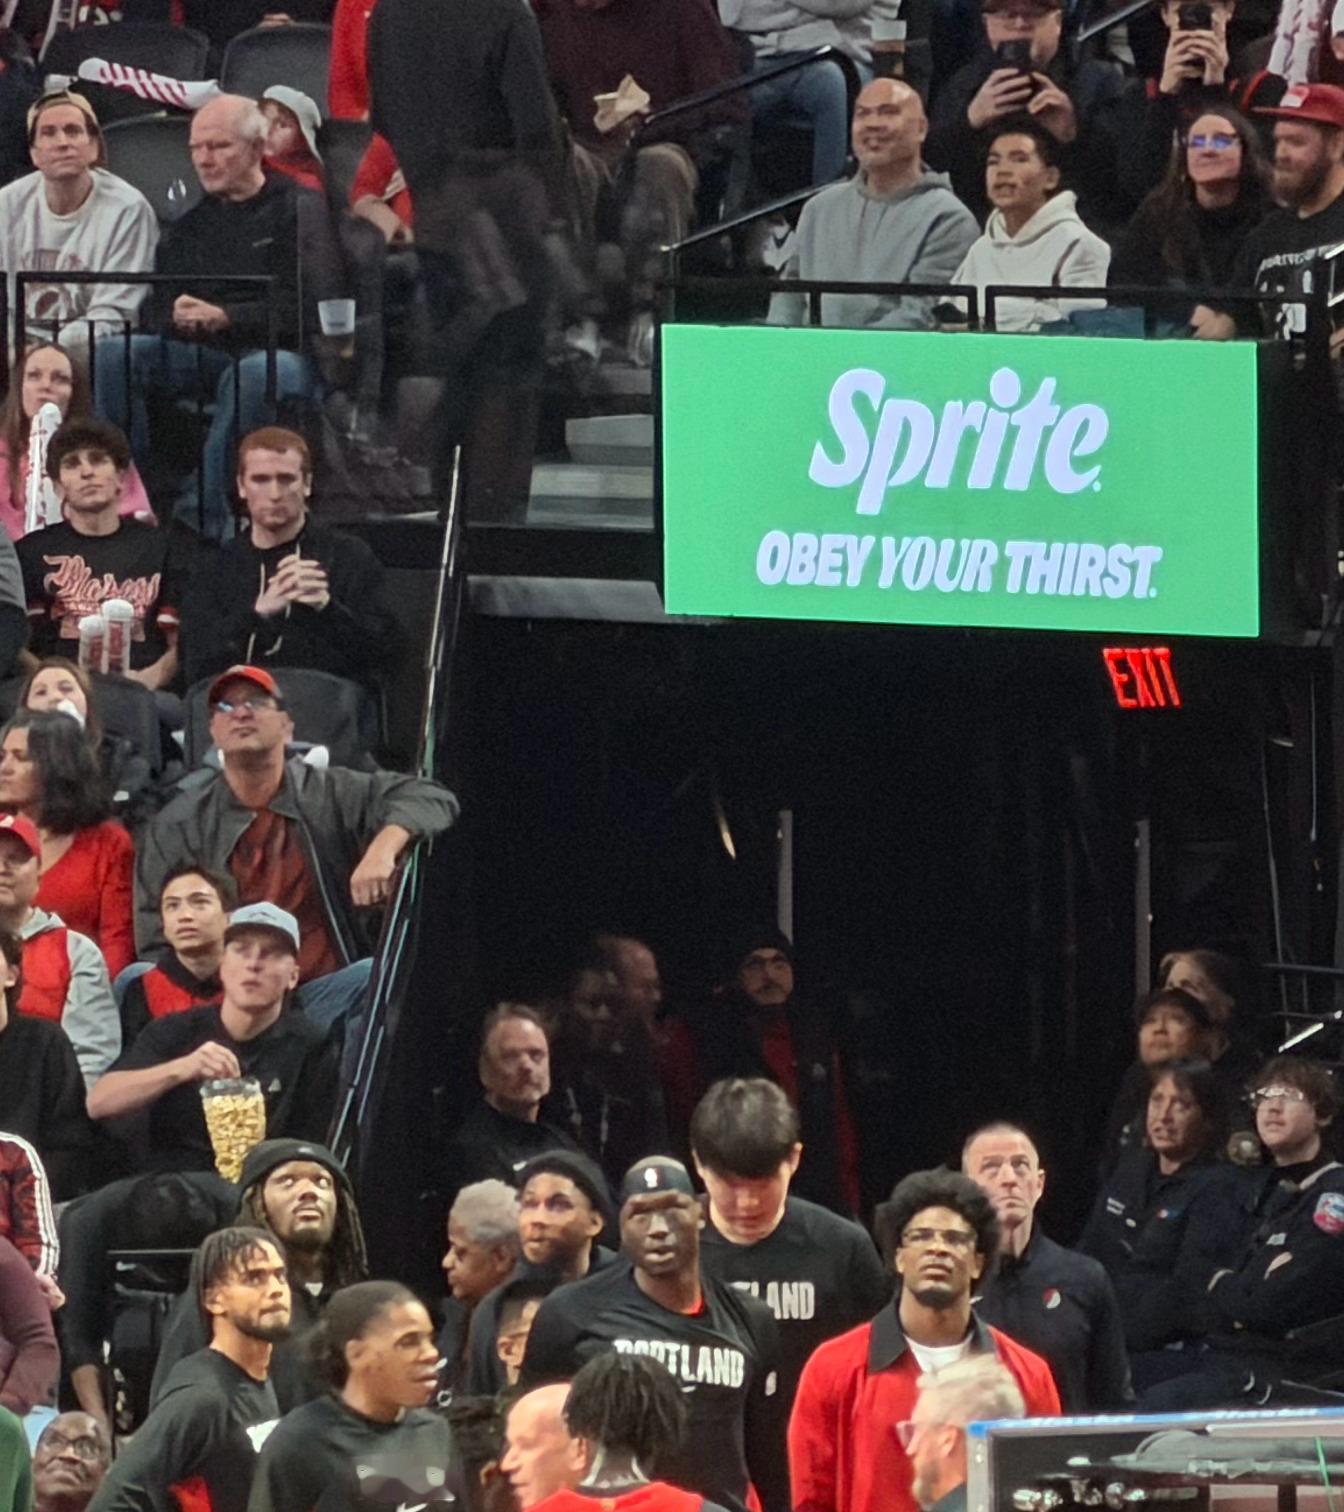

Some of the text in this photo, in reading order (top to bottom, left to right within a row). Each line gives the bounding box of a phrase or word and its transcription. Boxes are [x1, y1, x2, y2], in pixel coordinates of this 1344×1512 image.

[808, 367, 1109, 515] Sprite
[756, 530, 875, 587] OBEY
[878, 536, 998, 593] YOUR
[1102, 647, 1182, 709] EXIT
